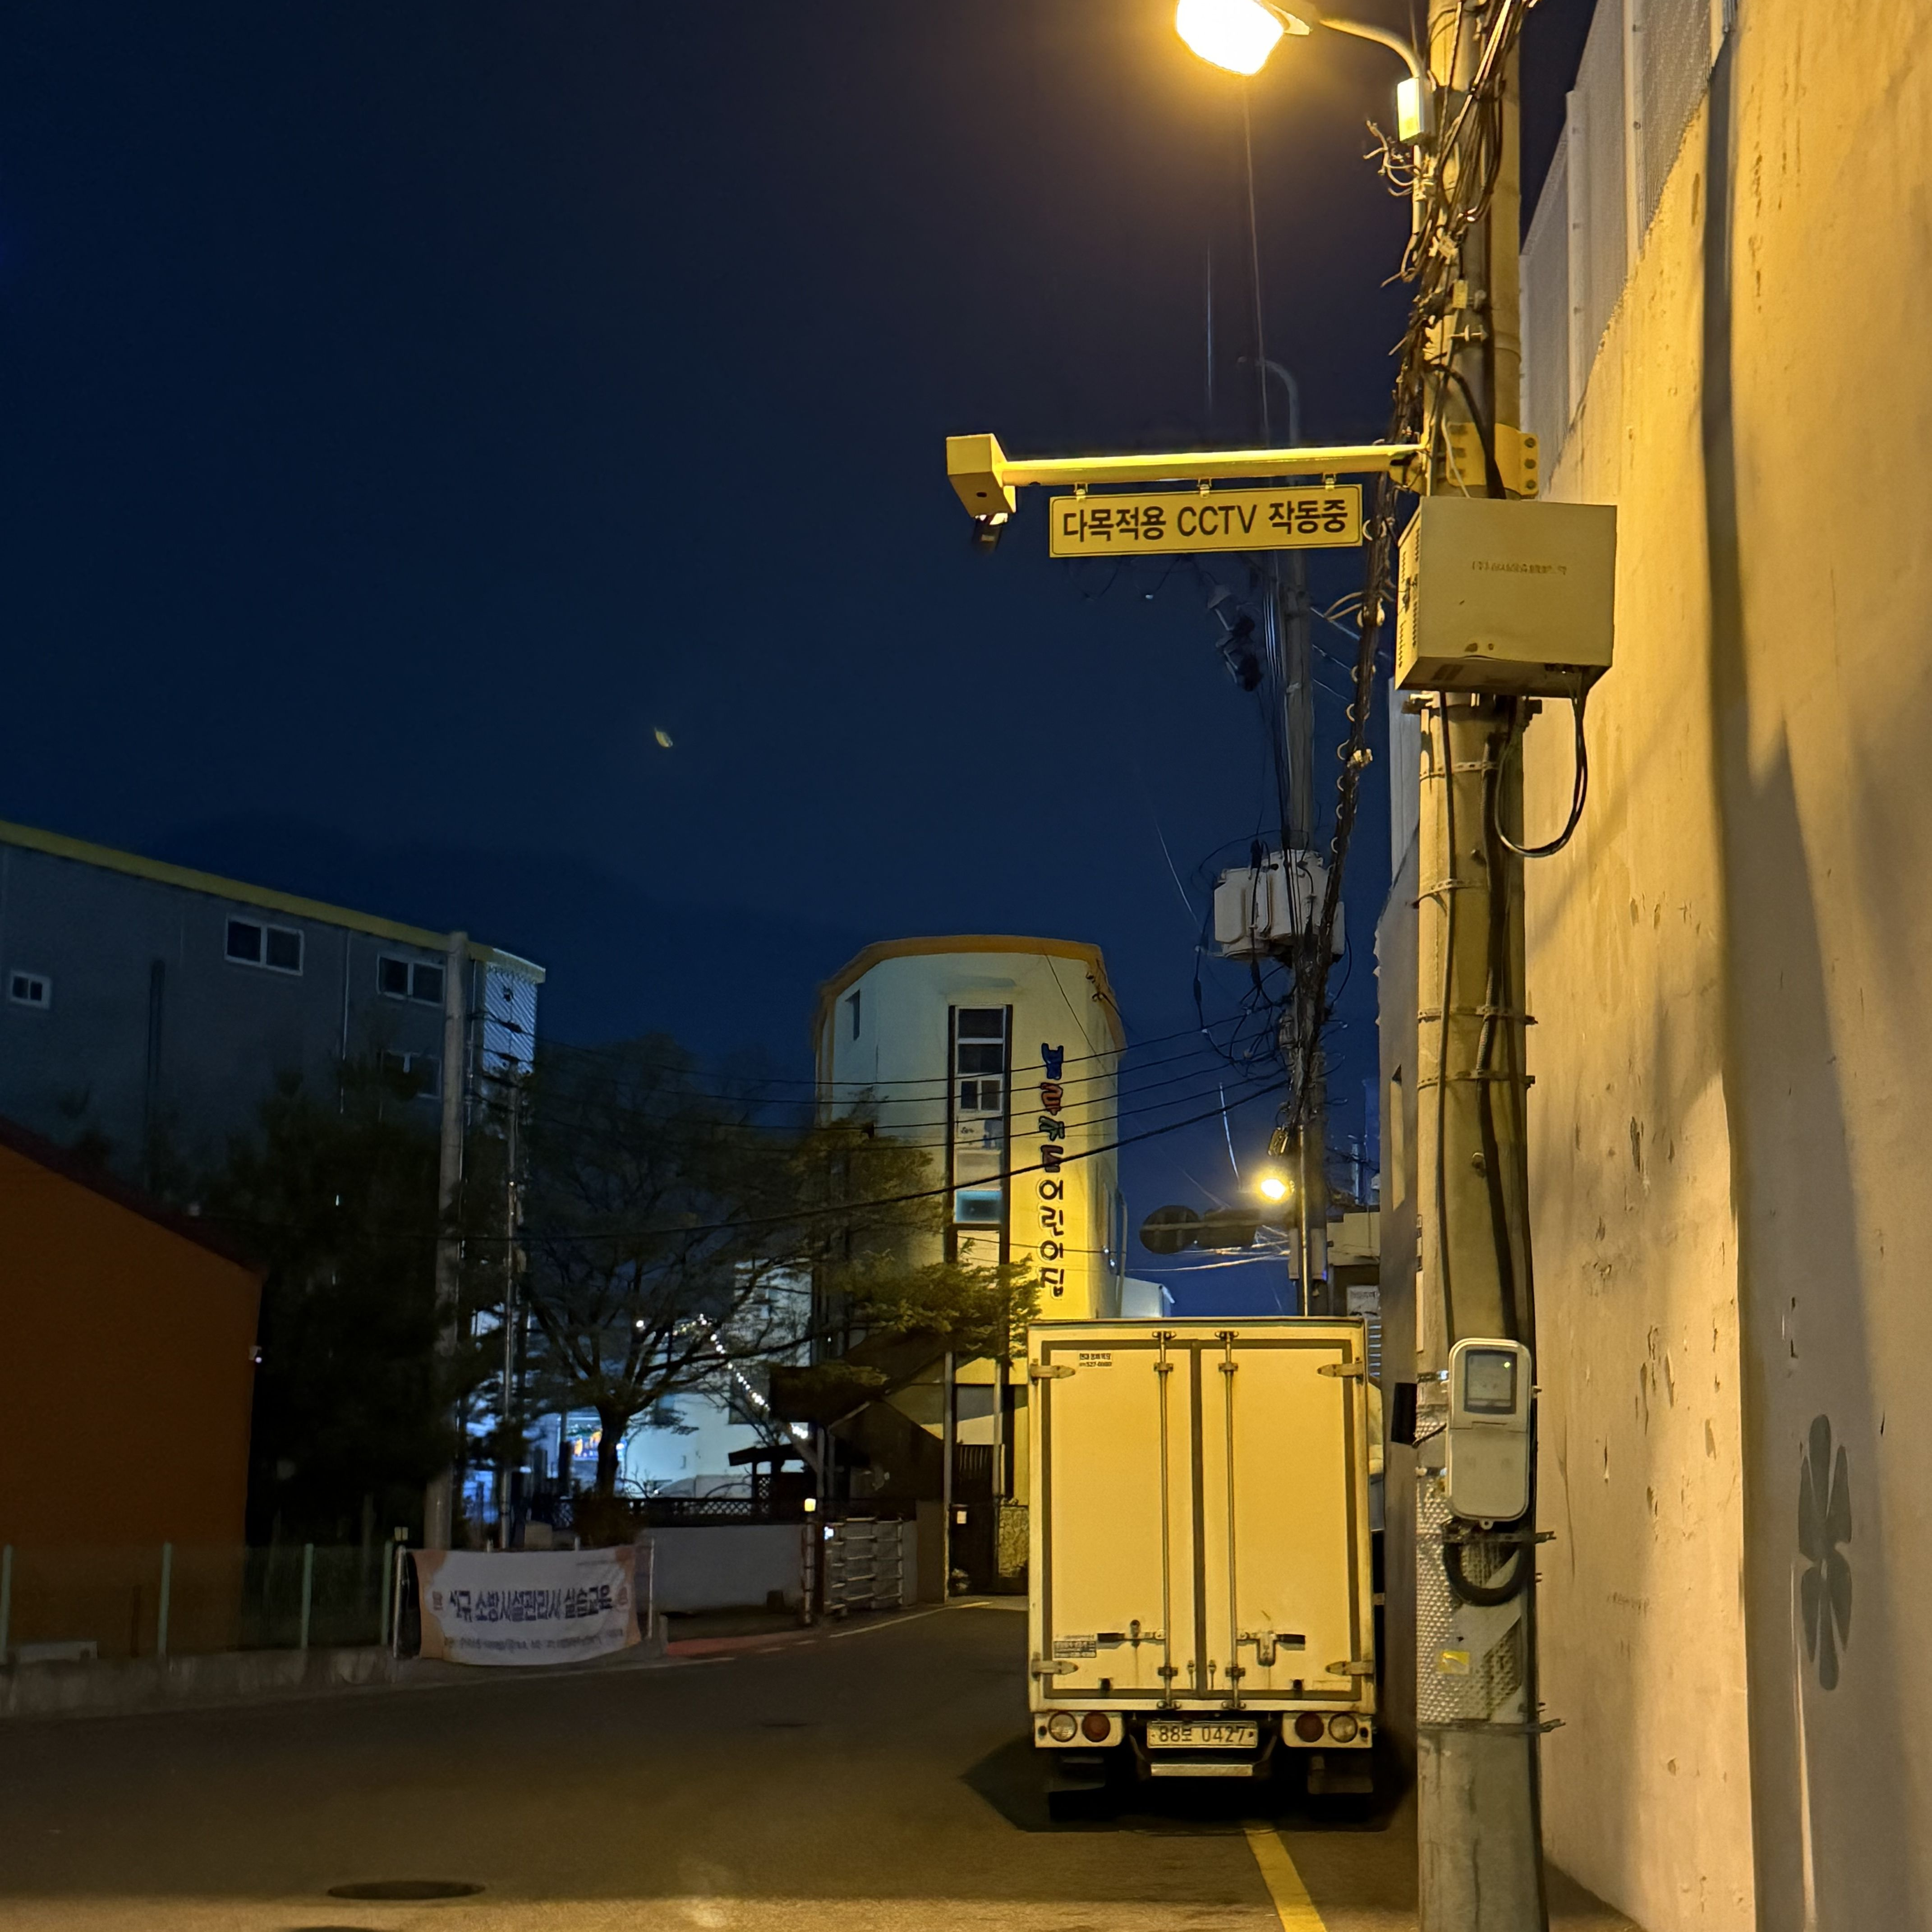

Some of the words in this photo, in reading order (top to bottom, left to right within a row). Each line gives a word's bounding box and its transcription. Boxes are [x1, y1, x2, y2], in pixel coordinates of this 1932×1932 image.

[1063, 505, 1167, 543] 다목적용
[1177, 504, 1257, 537] CCTV
[1268, 498, 1348, 535] 작동중
[1039, 1179, 1064, 1297] 어린이집
[1202, 1725, 1245, 1743] 0427
